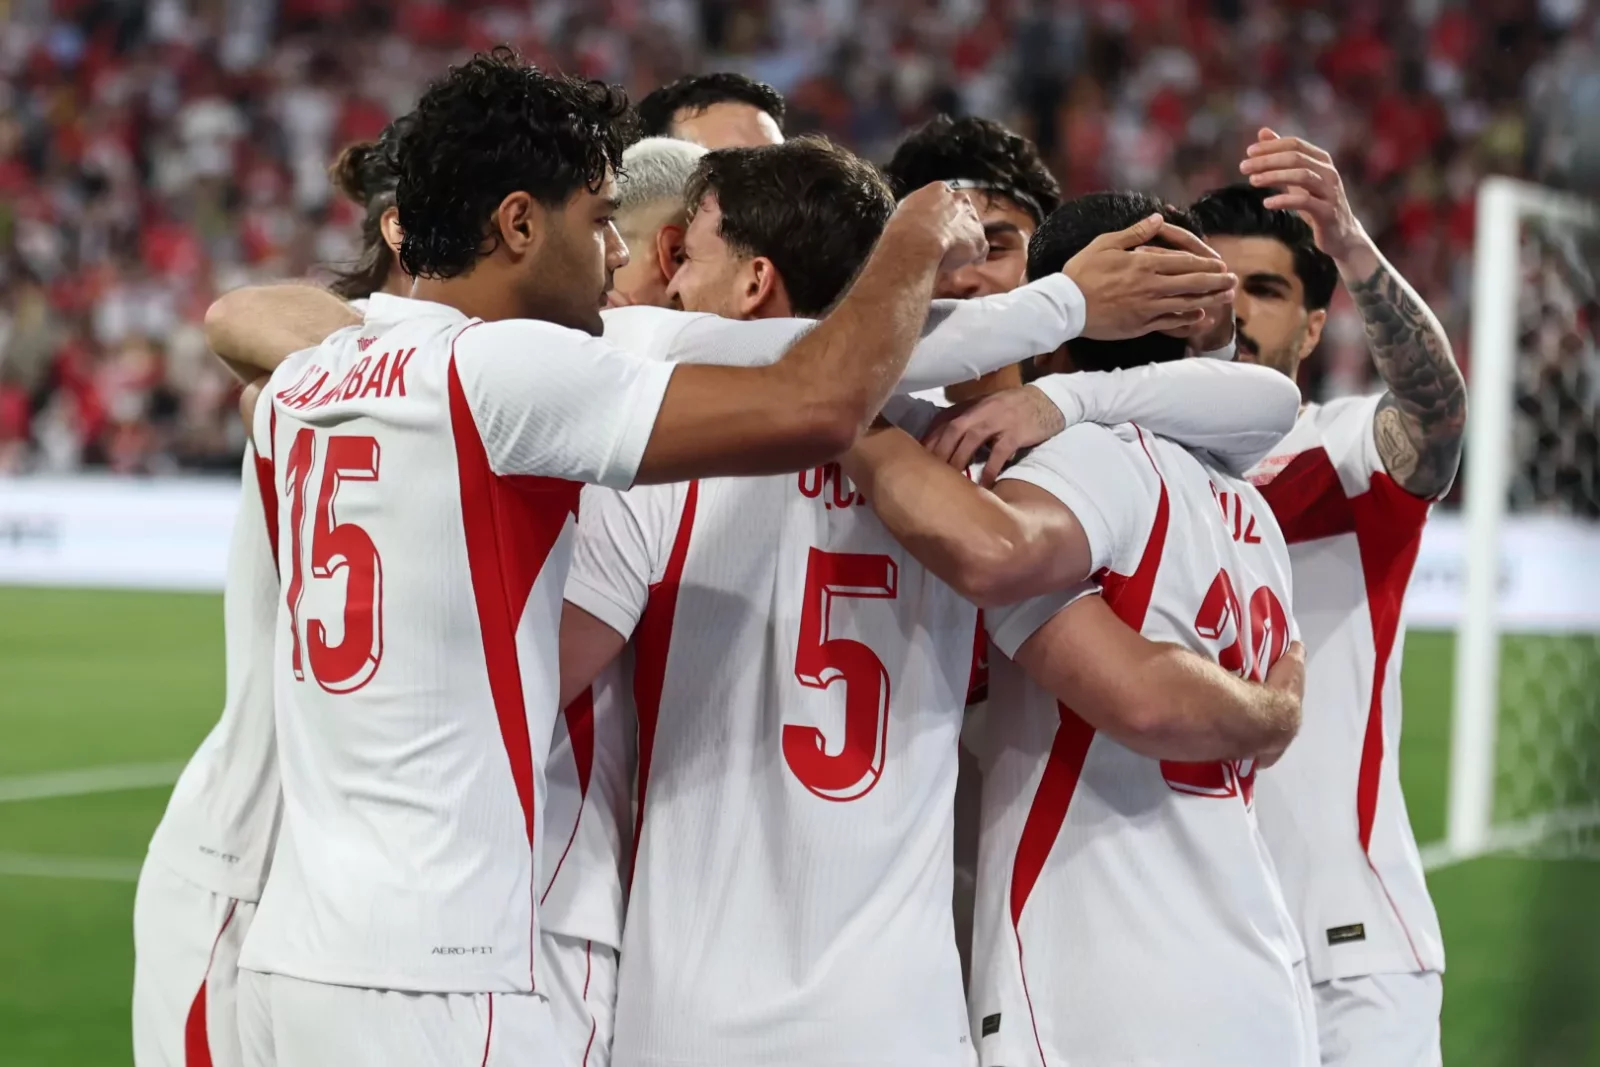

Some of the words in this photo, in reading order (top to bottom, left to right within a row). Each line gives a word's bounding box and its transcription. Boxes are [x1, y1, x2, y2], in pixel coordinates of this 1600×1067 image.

[286, 423, 383, 695] 15
[782, 546, 898, 802] 5
[431, 945, 493, 956] AERO-FIT
